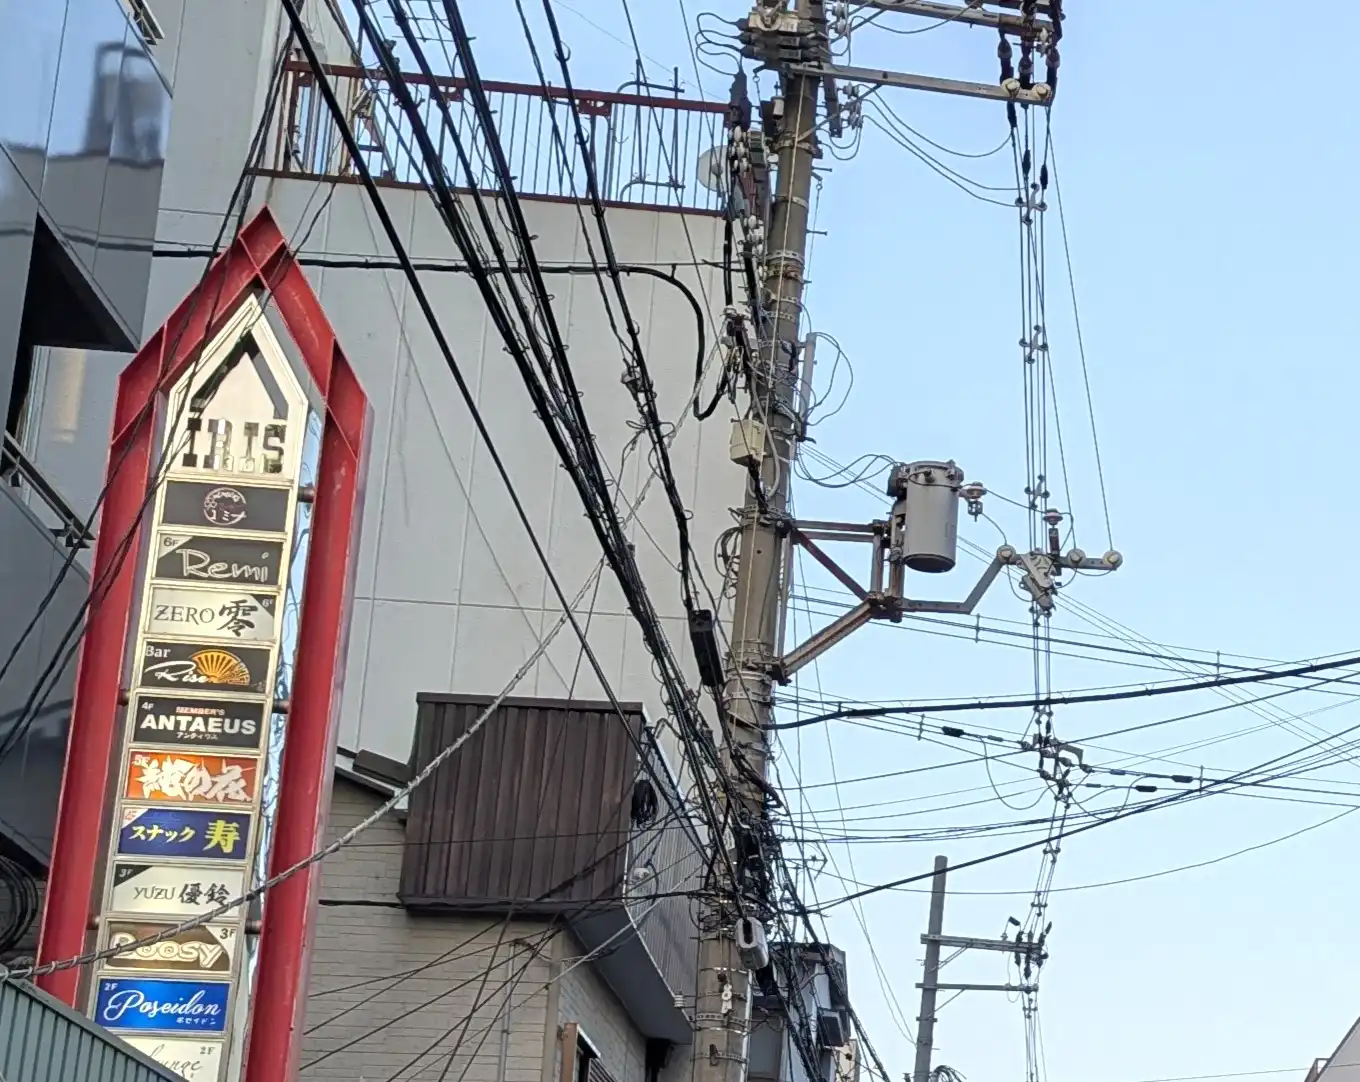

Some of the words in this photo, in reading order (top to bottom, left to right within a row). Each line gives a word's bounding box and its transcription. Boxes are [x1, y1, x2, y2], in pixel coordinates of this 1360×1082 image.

[163, 536, 180, 547] 6F
[175, 549, 269, 583] Remi
[153, 604, 215, 624] ZERO
[218, 599, 258, 637] 零
[144, 645, 171, 658] Bar
[144, 660, 209, 685] Rise
[140, 713, 256, 735] ANTAEUS
[128, 824, 196, 843] スナック
[203, 819, 241, 853] 寿
[134, 885, 177, 901] YUZU
[178, 882, 231, 912] 優鈴
[220, 928, 236, 940] 3F
[104, 989, 221, 1021] Poseidon
[176, 1017, 217, 1025] ポセイドン
